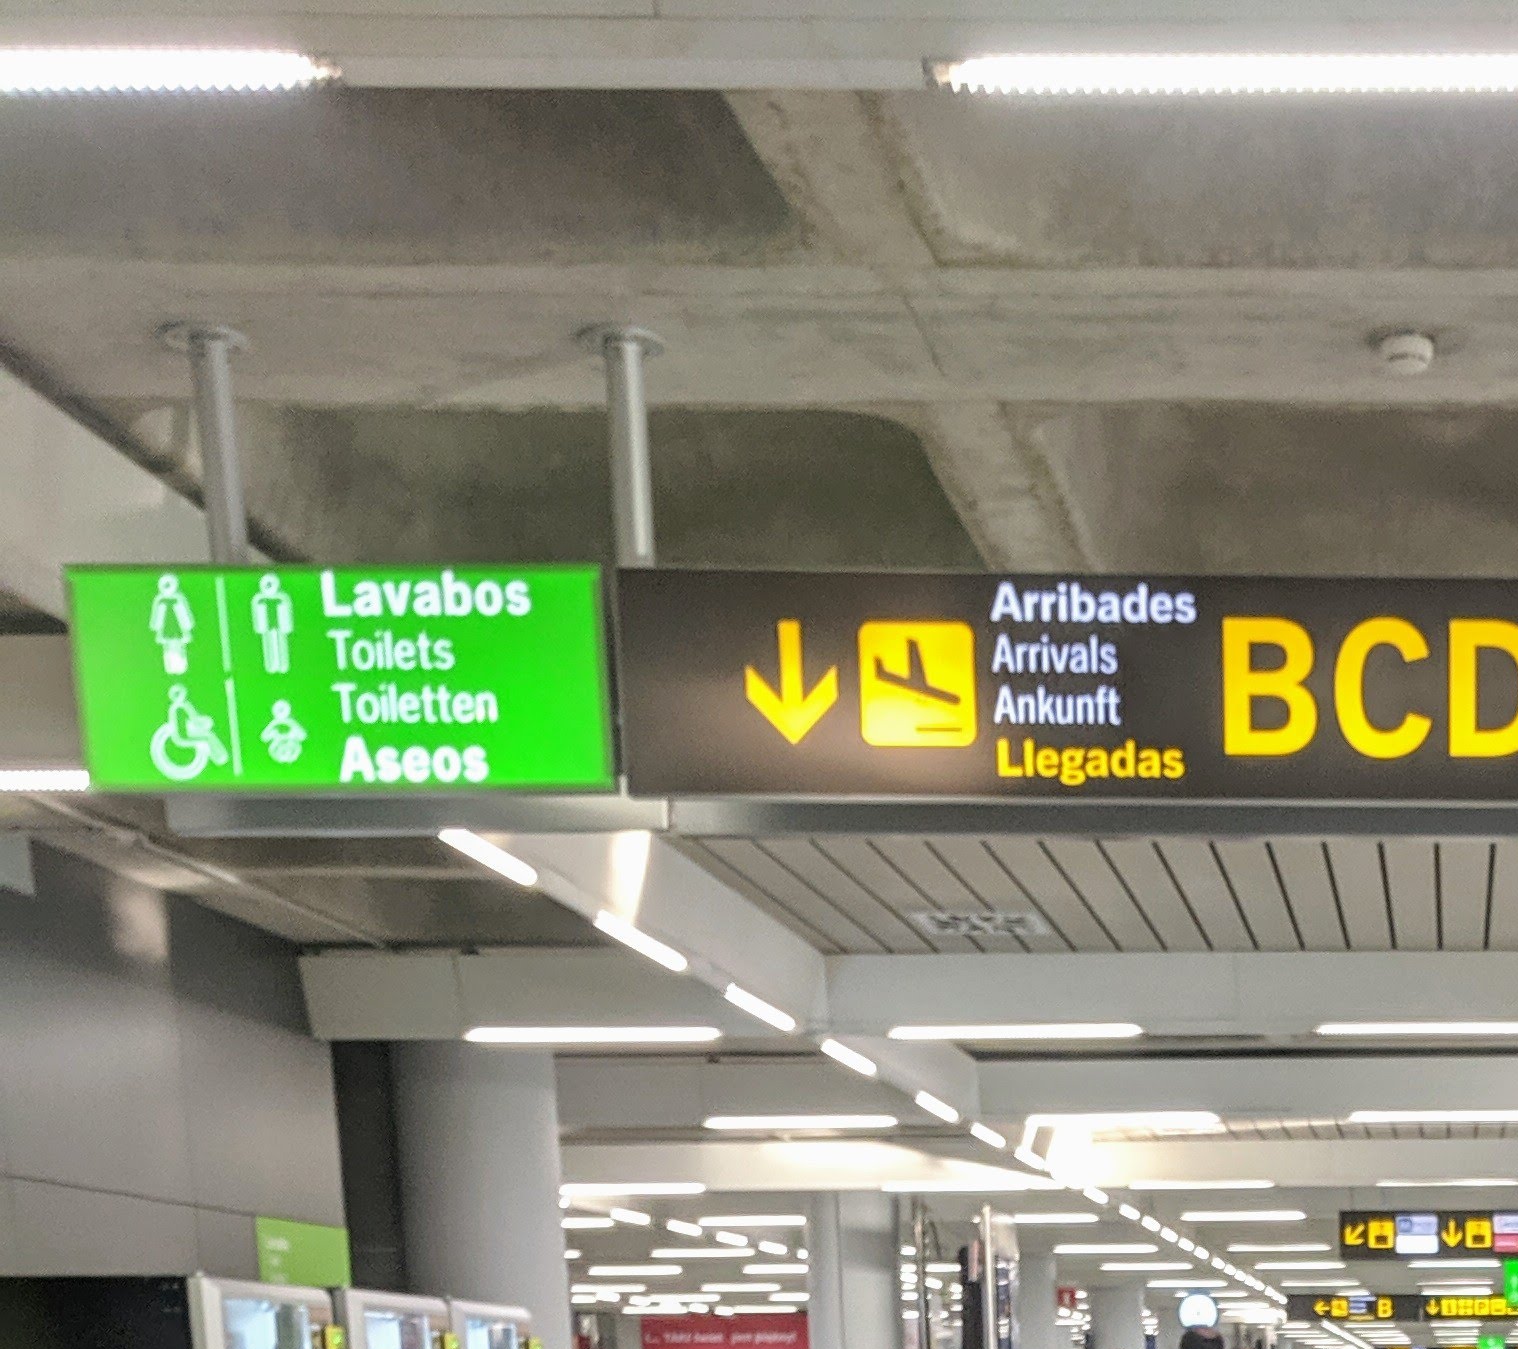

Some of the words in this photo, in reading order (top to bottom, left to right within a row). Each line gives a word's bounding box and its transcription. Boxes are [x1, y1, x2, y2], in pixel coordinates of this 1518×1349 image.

[321, 569, 532, 617] Lavabos
[991, 583, 1196, 625] Arribades
[327, 629, 455, 670] Toilets
[992, 634, 1118, 676] Arrivals
[332, 683, 499, 724] Toiletten
[993, 686, 1122, 726] Ankunft
[339, 735, 489, 783] Aseos
[996, 738, 1185, 786] Llegadas
